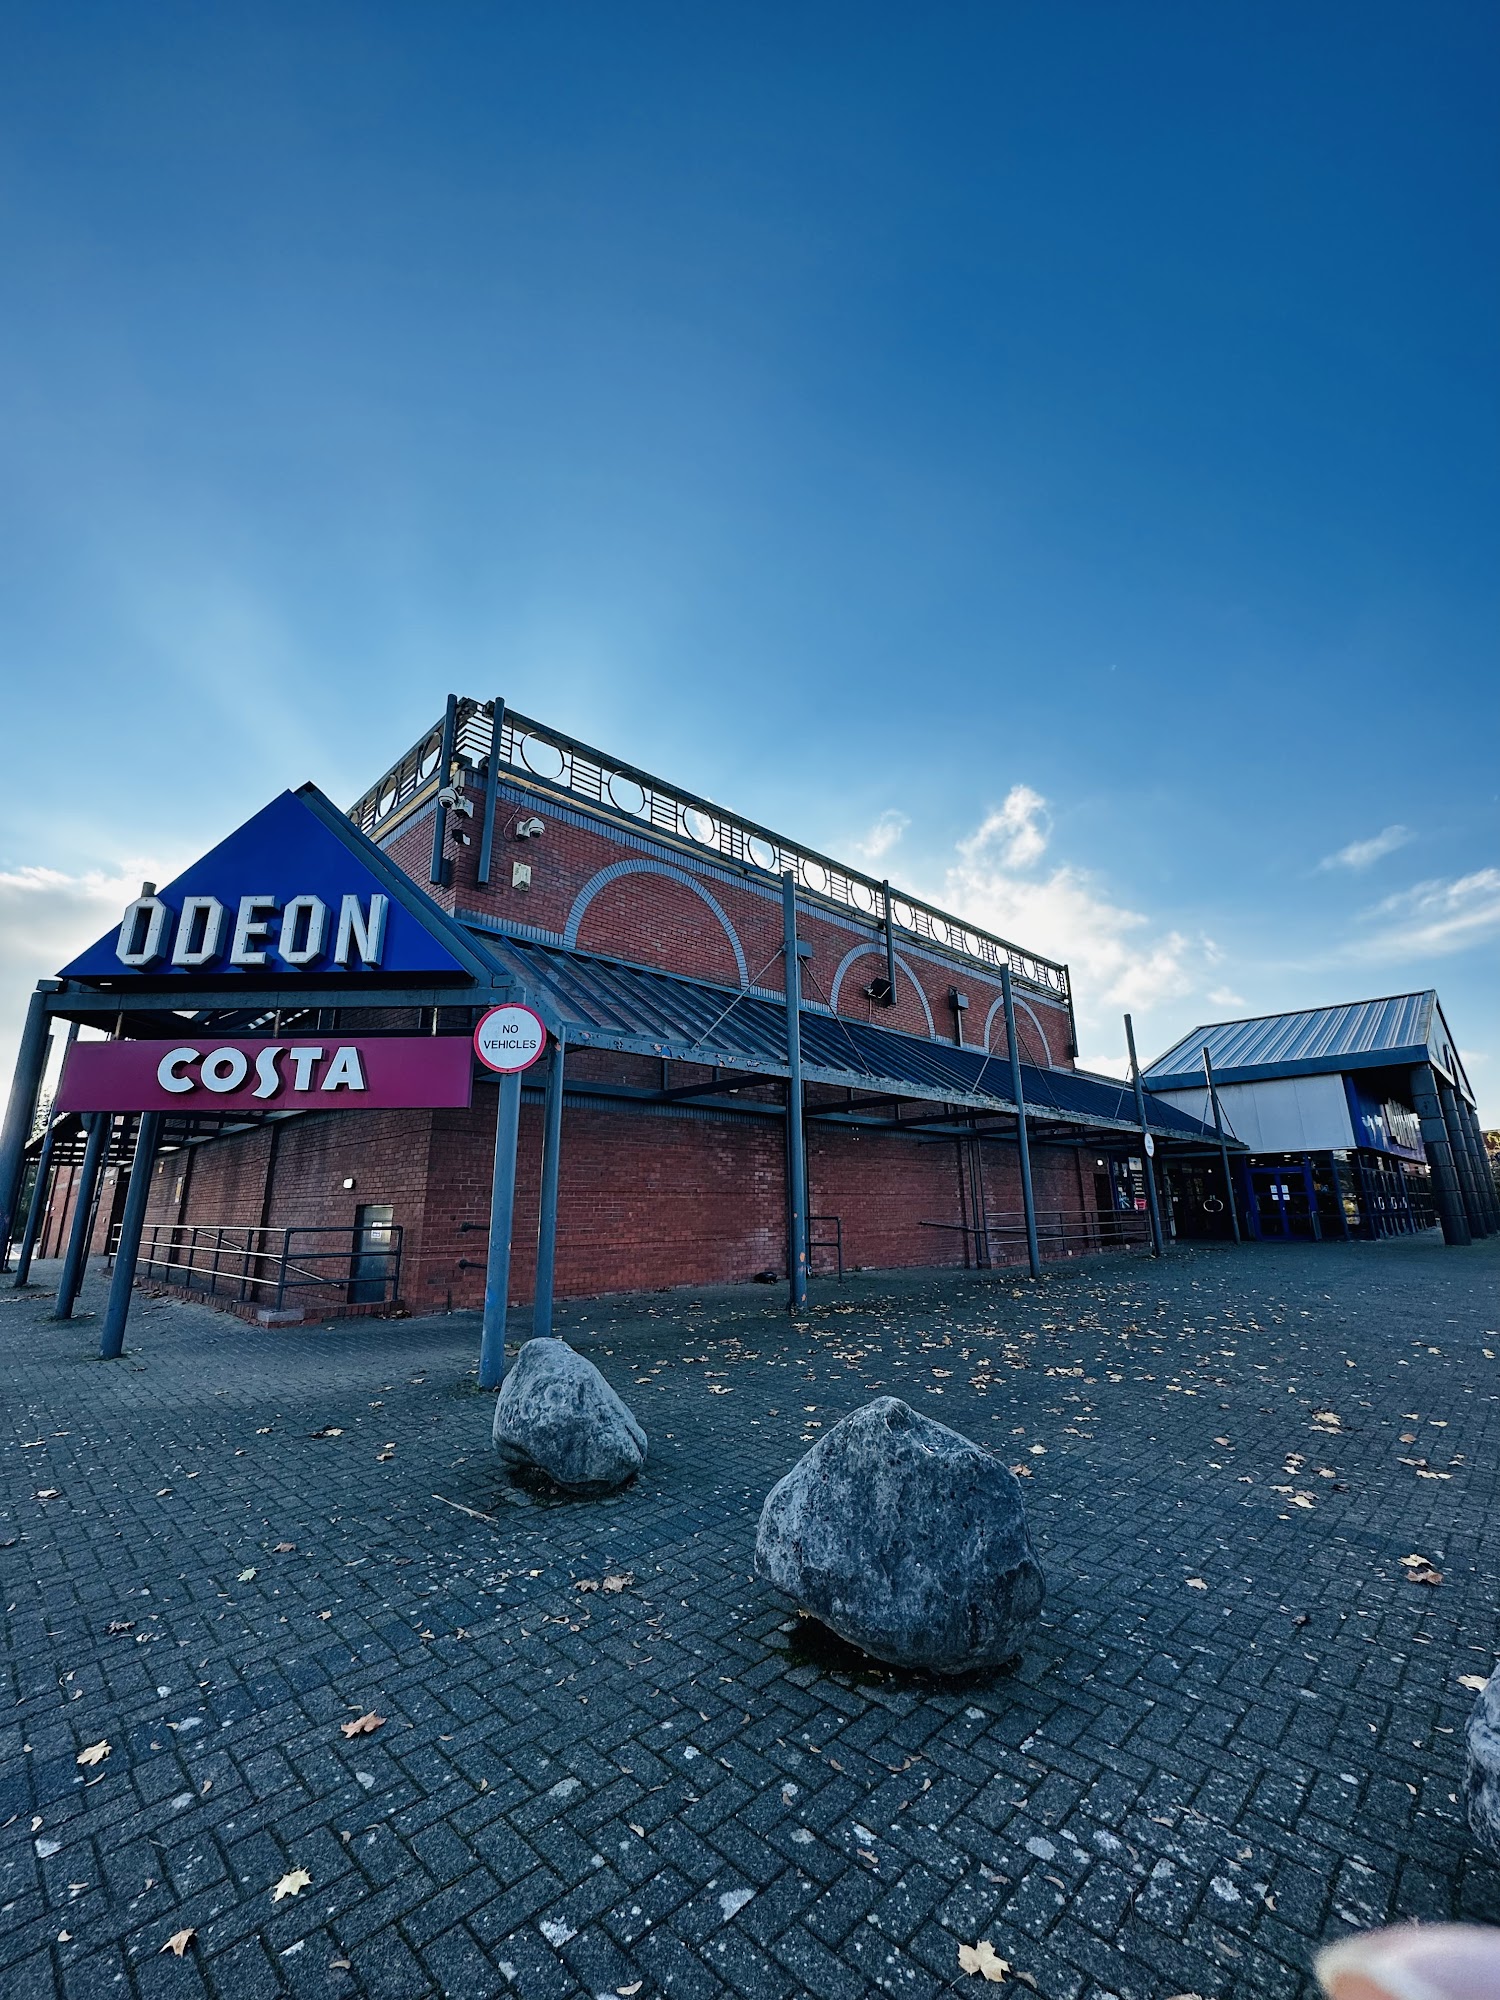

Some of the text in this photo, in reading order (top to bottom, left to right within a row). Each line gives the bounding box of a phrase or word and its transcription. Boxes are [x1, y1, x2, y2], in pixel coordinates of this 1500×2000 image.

[115, 894, 388, 967] ODEON
[483, 1039, 537, 1049] VEHICLES
[502, 1024, 519, 1034] NO
[157, 1046, 366, 1099] COSTA
